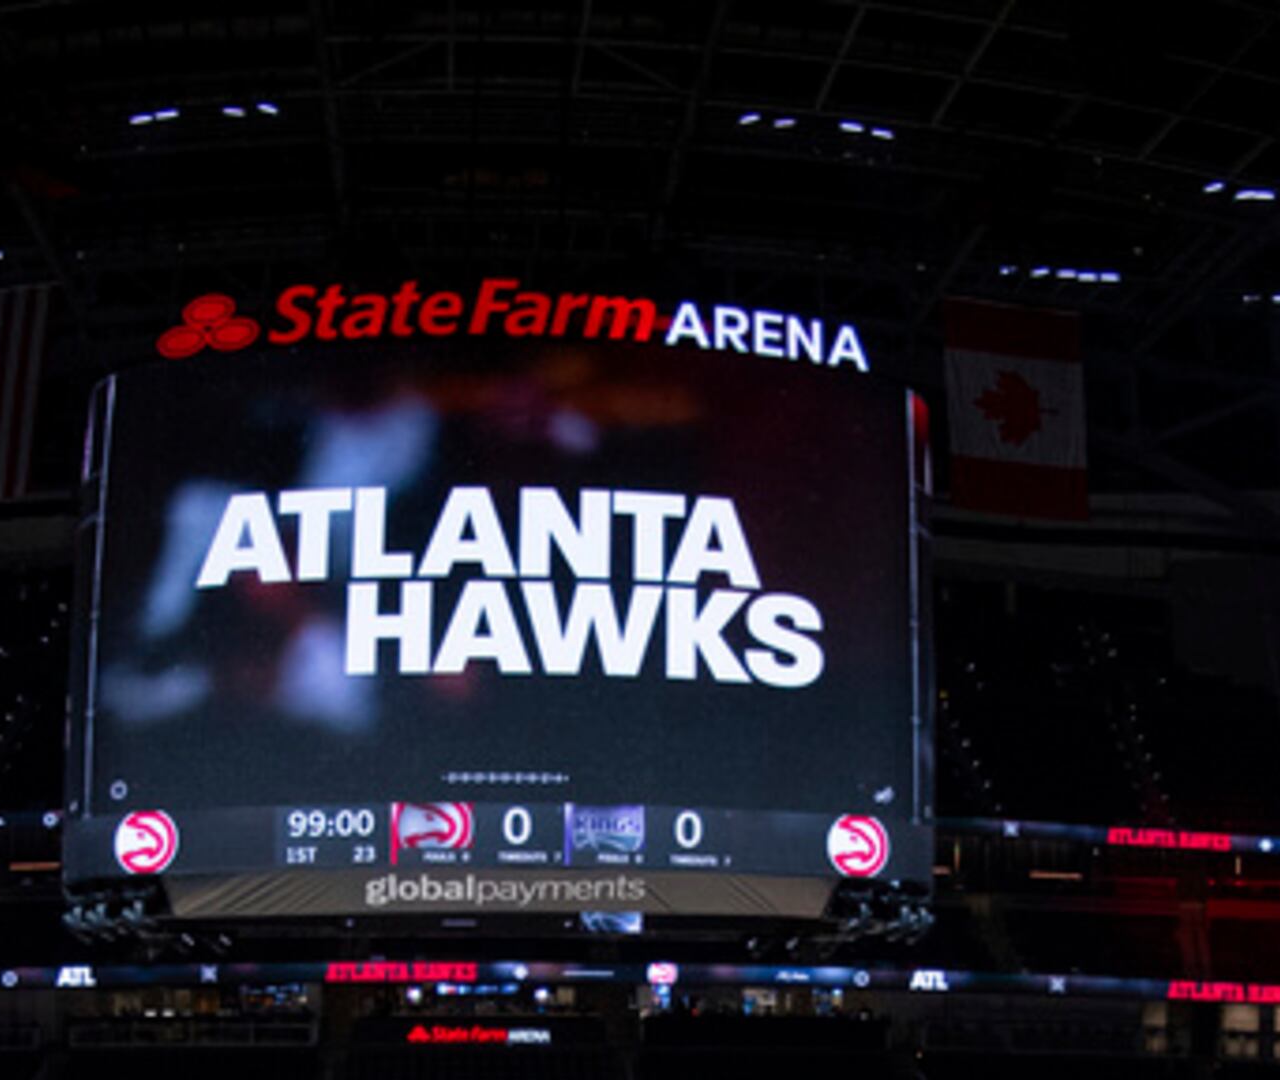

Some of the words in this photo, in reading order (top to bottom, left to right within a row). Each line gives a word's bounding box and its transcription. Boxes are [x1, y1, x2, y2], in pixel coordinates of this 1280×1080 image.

[665, 302, 868, 373] ARENA
[194, 486, 762, 592] ATLANTA
[343, 580, 826, 690] HAWKS
[287, 808, 375, 838] 99:00
[503, 806, 532, 845] 0
[675, 810, 703, 849] 0
[1107, 828, 1175, 850] ATLANTA
[1178, 832, 1233, 852] HAWKS
[286, 846, 318, 864] 1ST
[352, 845, 376, 863] 23
[365, 873, 646, 907] globalpayments
[55, 965, 97, 988] ATL
[325, 961, 409, 983] ATLANTA
[412, 961, 478, 982] HAWKS
[907, 969, 950, 992] ATL
[1167, 979, 1244, 1001] ATLANTA
